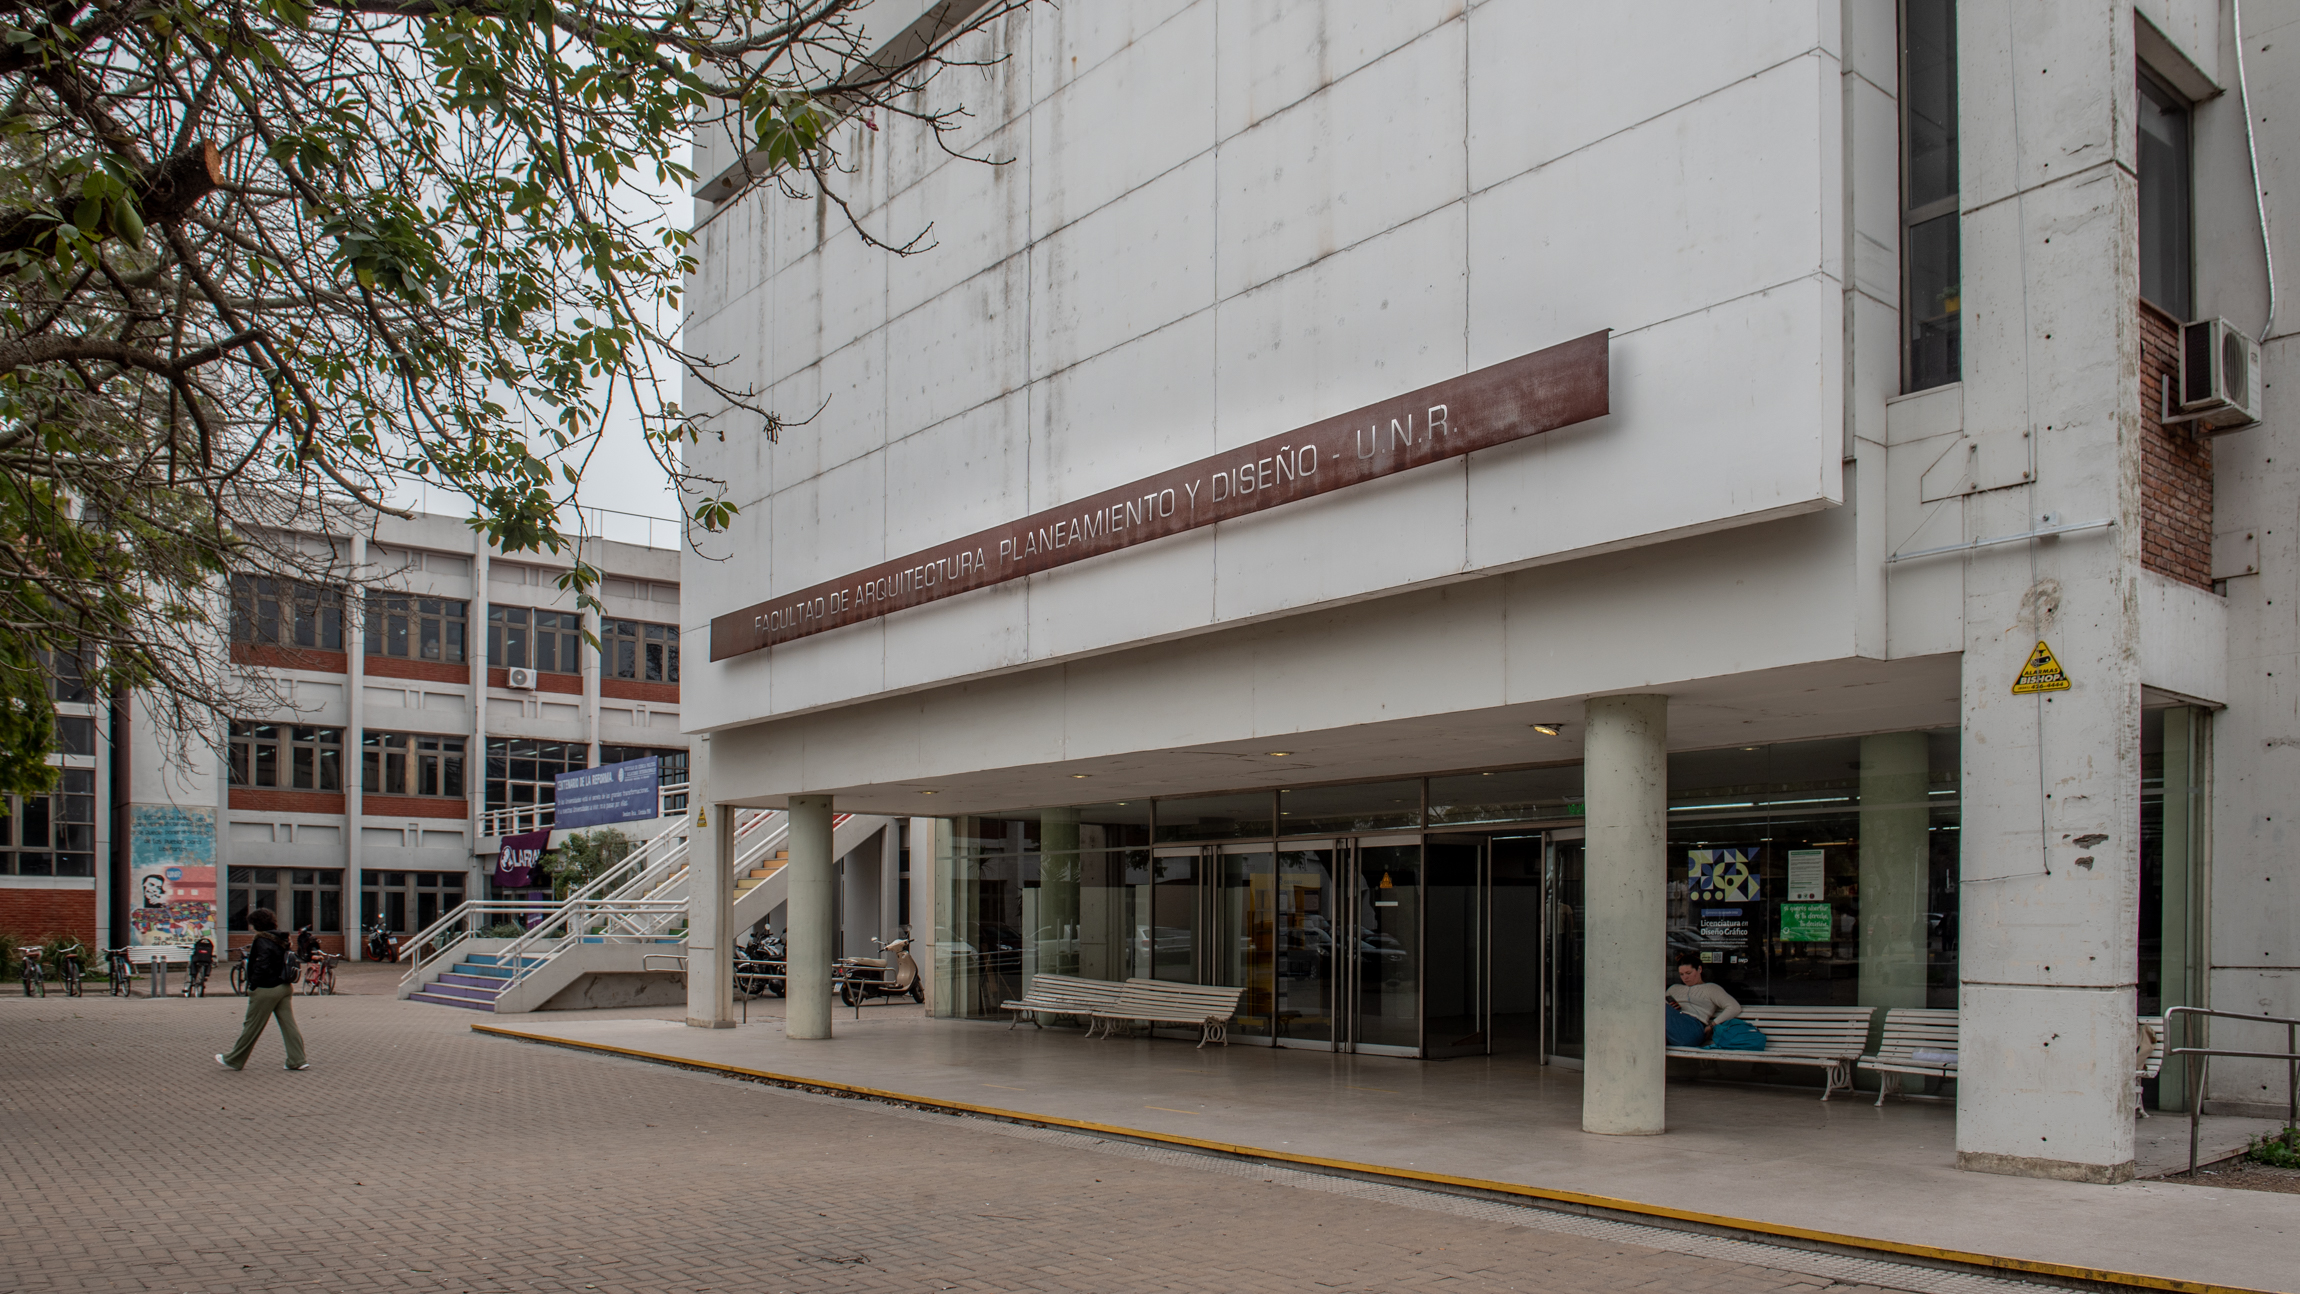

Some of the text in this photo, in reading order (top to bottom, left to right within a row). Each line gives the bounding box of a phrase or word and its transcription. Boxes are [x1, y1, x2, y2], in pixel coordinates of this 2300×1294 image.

[754, 597, 825, 636] FACULTAD
[830, 588, 849, 615] DE
[855, 547, 986, 608] ARQUITECTURA
[999, 488, 1175, 565] PLANEAMIENTO
[1185, 478, 1201, 509] Y
[1212, 444, 1317, 503] DISEÑO
[1356, 403, 1458, 461] U.N.R.
[2024, 667, 2058, 675] ALARMAS
[2020, 674, 2060, 685] BISHOP
[2031, 681, 2064, 690] 426-4444
[557, 777, 579, 791] CENTENARIO
[580, 776, 585, 787] DE
[585, 775, 592, 786] LA
[1700, 919, 1741, 927] Licenciatura
[1724, 927, 1748, 935] Gráfico
